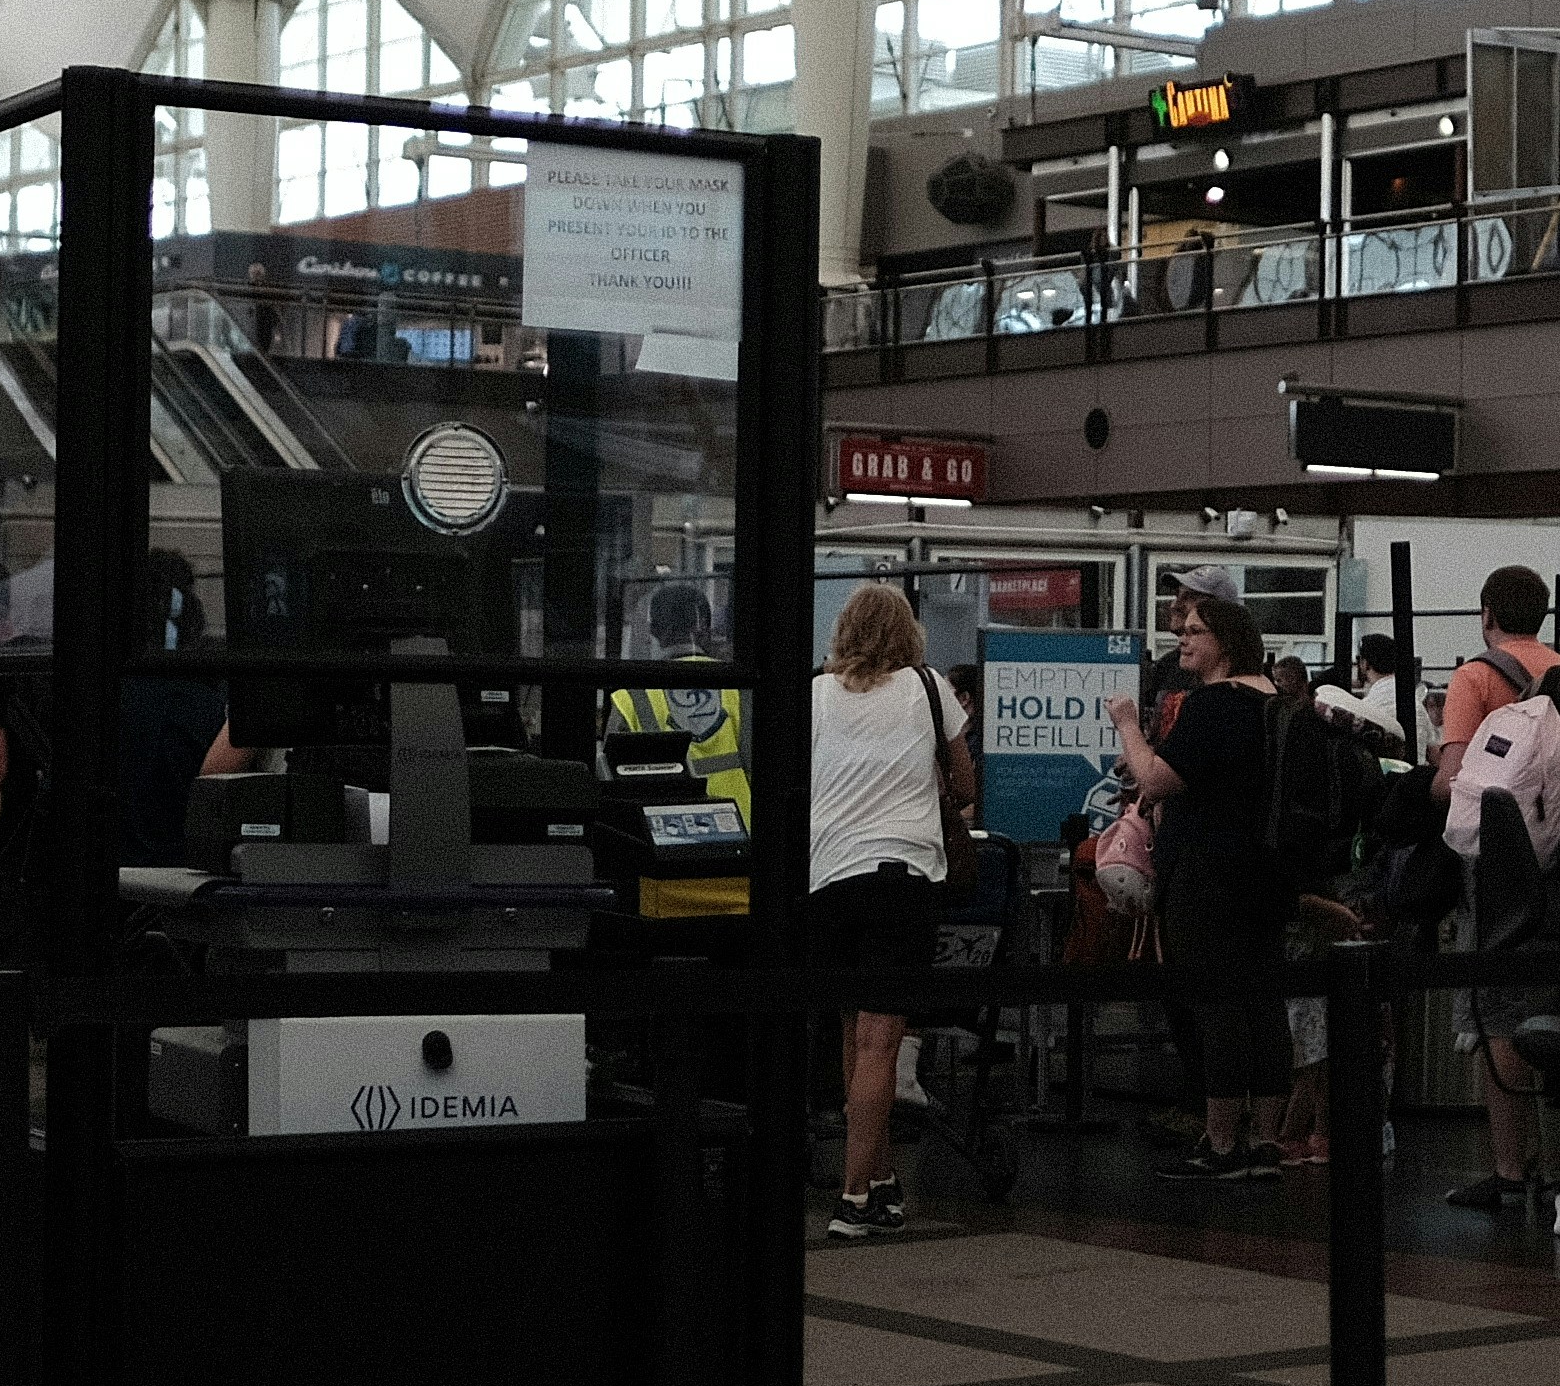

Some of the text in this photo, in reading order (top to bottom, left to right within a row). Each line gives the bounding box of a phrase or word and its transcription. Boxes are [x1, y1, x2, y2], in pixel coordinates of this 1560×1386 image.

[548, 170, 730, 193] PLEASE TAKE YOUR MASK
[573, 196, 707, 216] DOWN WHEN YOU
[548, 219, 730, 242] PRESENT YOUR ID TO THE
[611, 247, 671, 264] OFFICER
[298, 257, 484, 288] Caribou COFFEE
[589, 273, 693, 291] THANK YOU!!!
[851, 451, 973, 483] GRAB & GO
[997, 667, 1123, 691] EMPTY IT
[997, 696, 1085, 720] HOLD
[996, 725, 1090, 748] REFILL
[410, 1094, 519, 1119] IDEMIA
